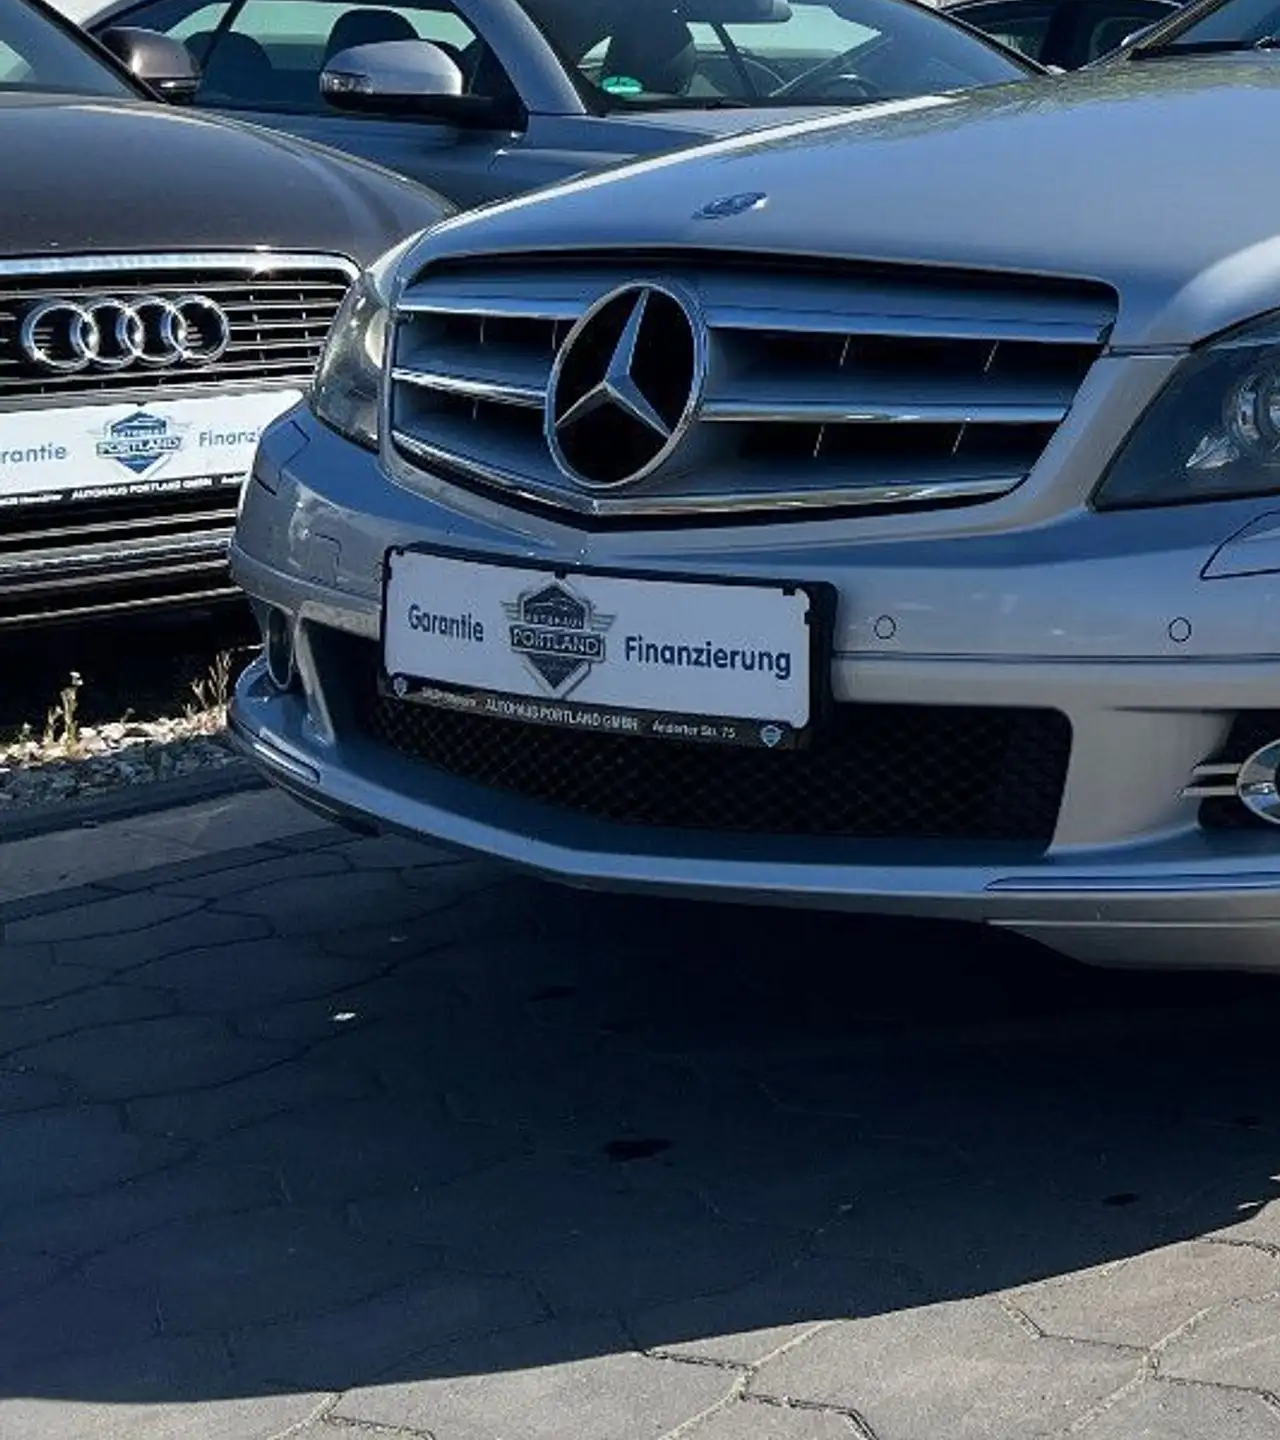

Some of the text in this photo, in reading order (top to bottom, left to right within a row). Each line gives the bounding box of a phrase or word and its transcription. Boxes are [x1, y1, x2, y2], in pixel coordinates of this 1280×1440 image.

[199, 426, 259, 448] Finanz
[0, 442, 66, 465] rantie
[407, 604, 484, 643] Garantie
[512, 627, 600, 654] PORTLAND
[624, 635, 791, 681] Finanzierung
[539, 707, 600, 727] PORTLAND
